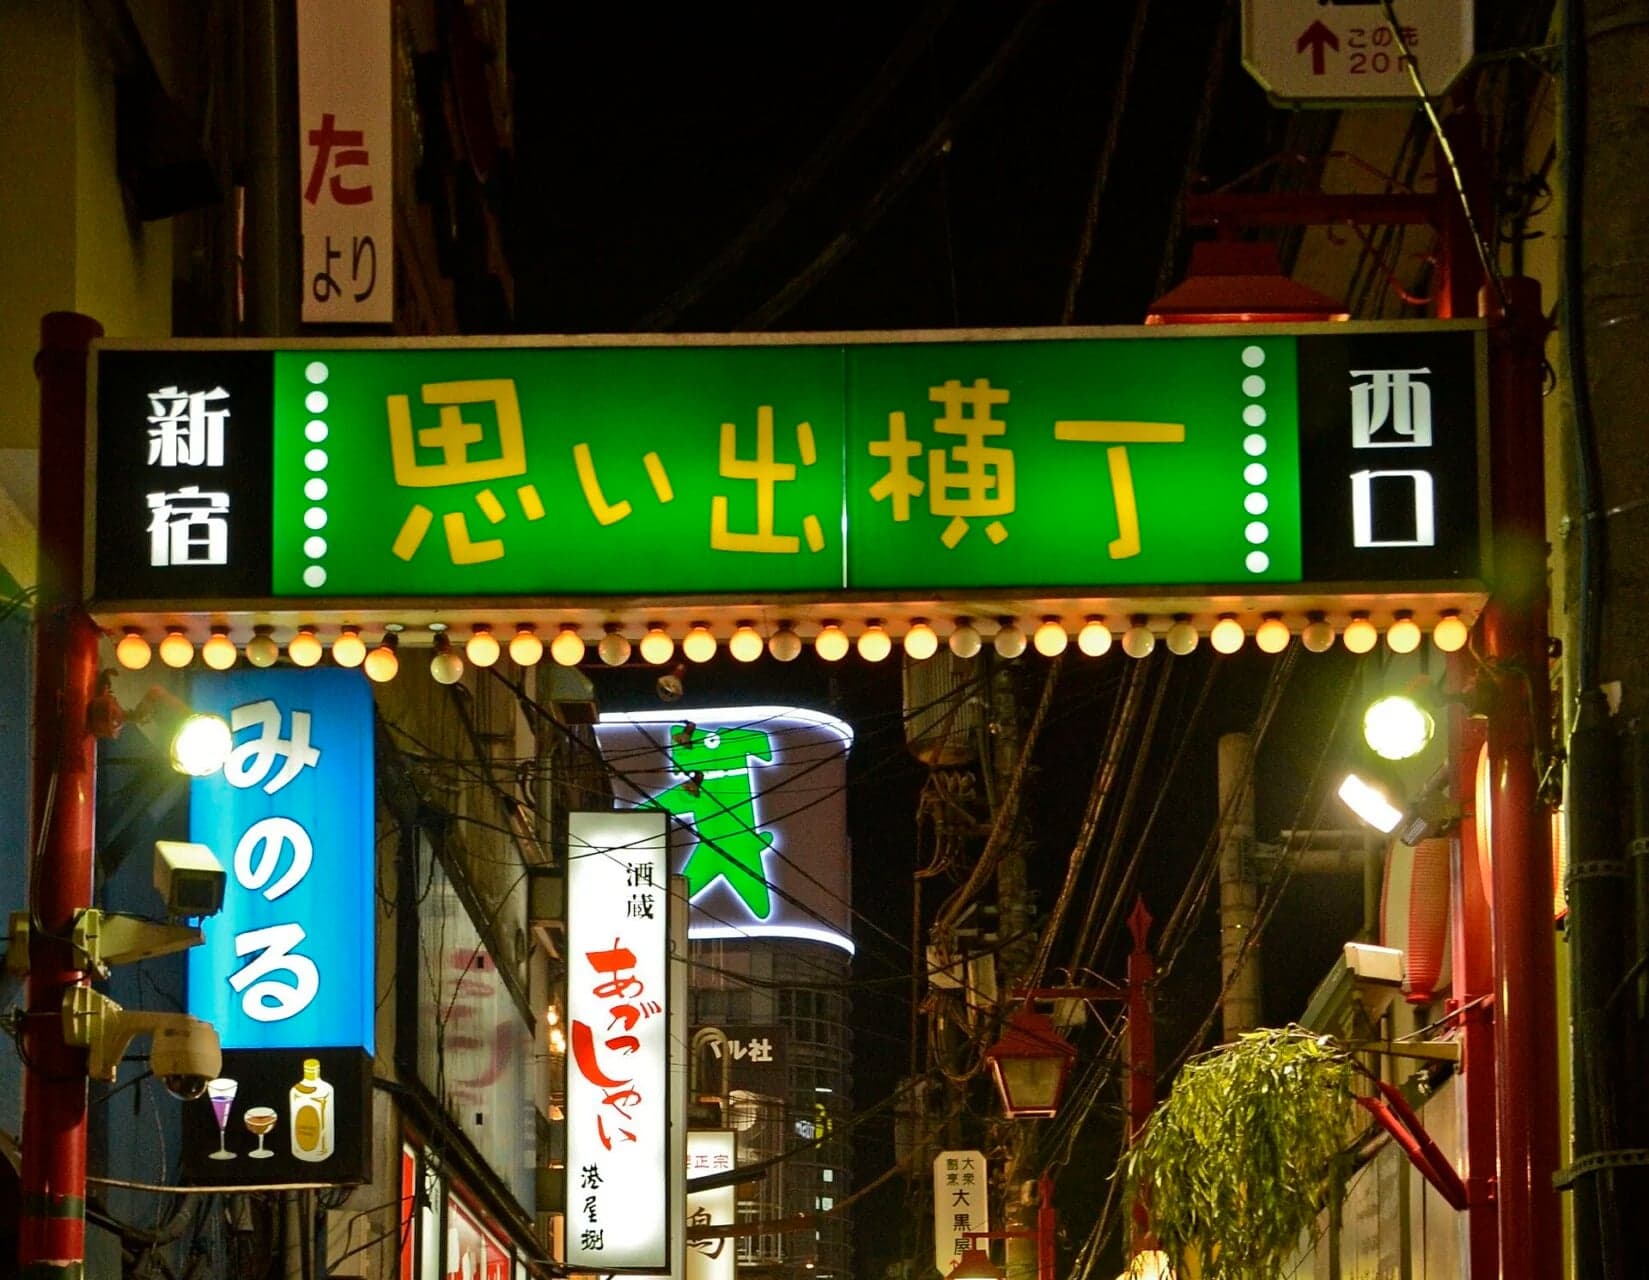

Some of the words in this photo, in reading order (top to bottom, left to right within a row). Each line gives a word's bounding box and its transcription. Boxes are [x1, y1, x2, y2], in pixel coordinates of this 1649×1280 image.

[304, 113, 374, 205] た
[311, 234, 377, 304] より
[146, 385, 231, 567] 新宿
[386, 377, 1186, 566] 思い出横丁
[1349, 367, 1436, 548] 西口
[222, 698, 322, 1023] みのる
[626, 861, 655, 920] 酒蔵
[571, 937, 662, 1152] あがっしゃい
[686, 1153, 729, 1169] 正宗
[952, 1188, 972, 1256] 大黒屋
